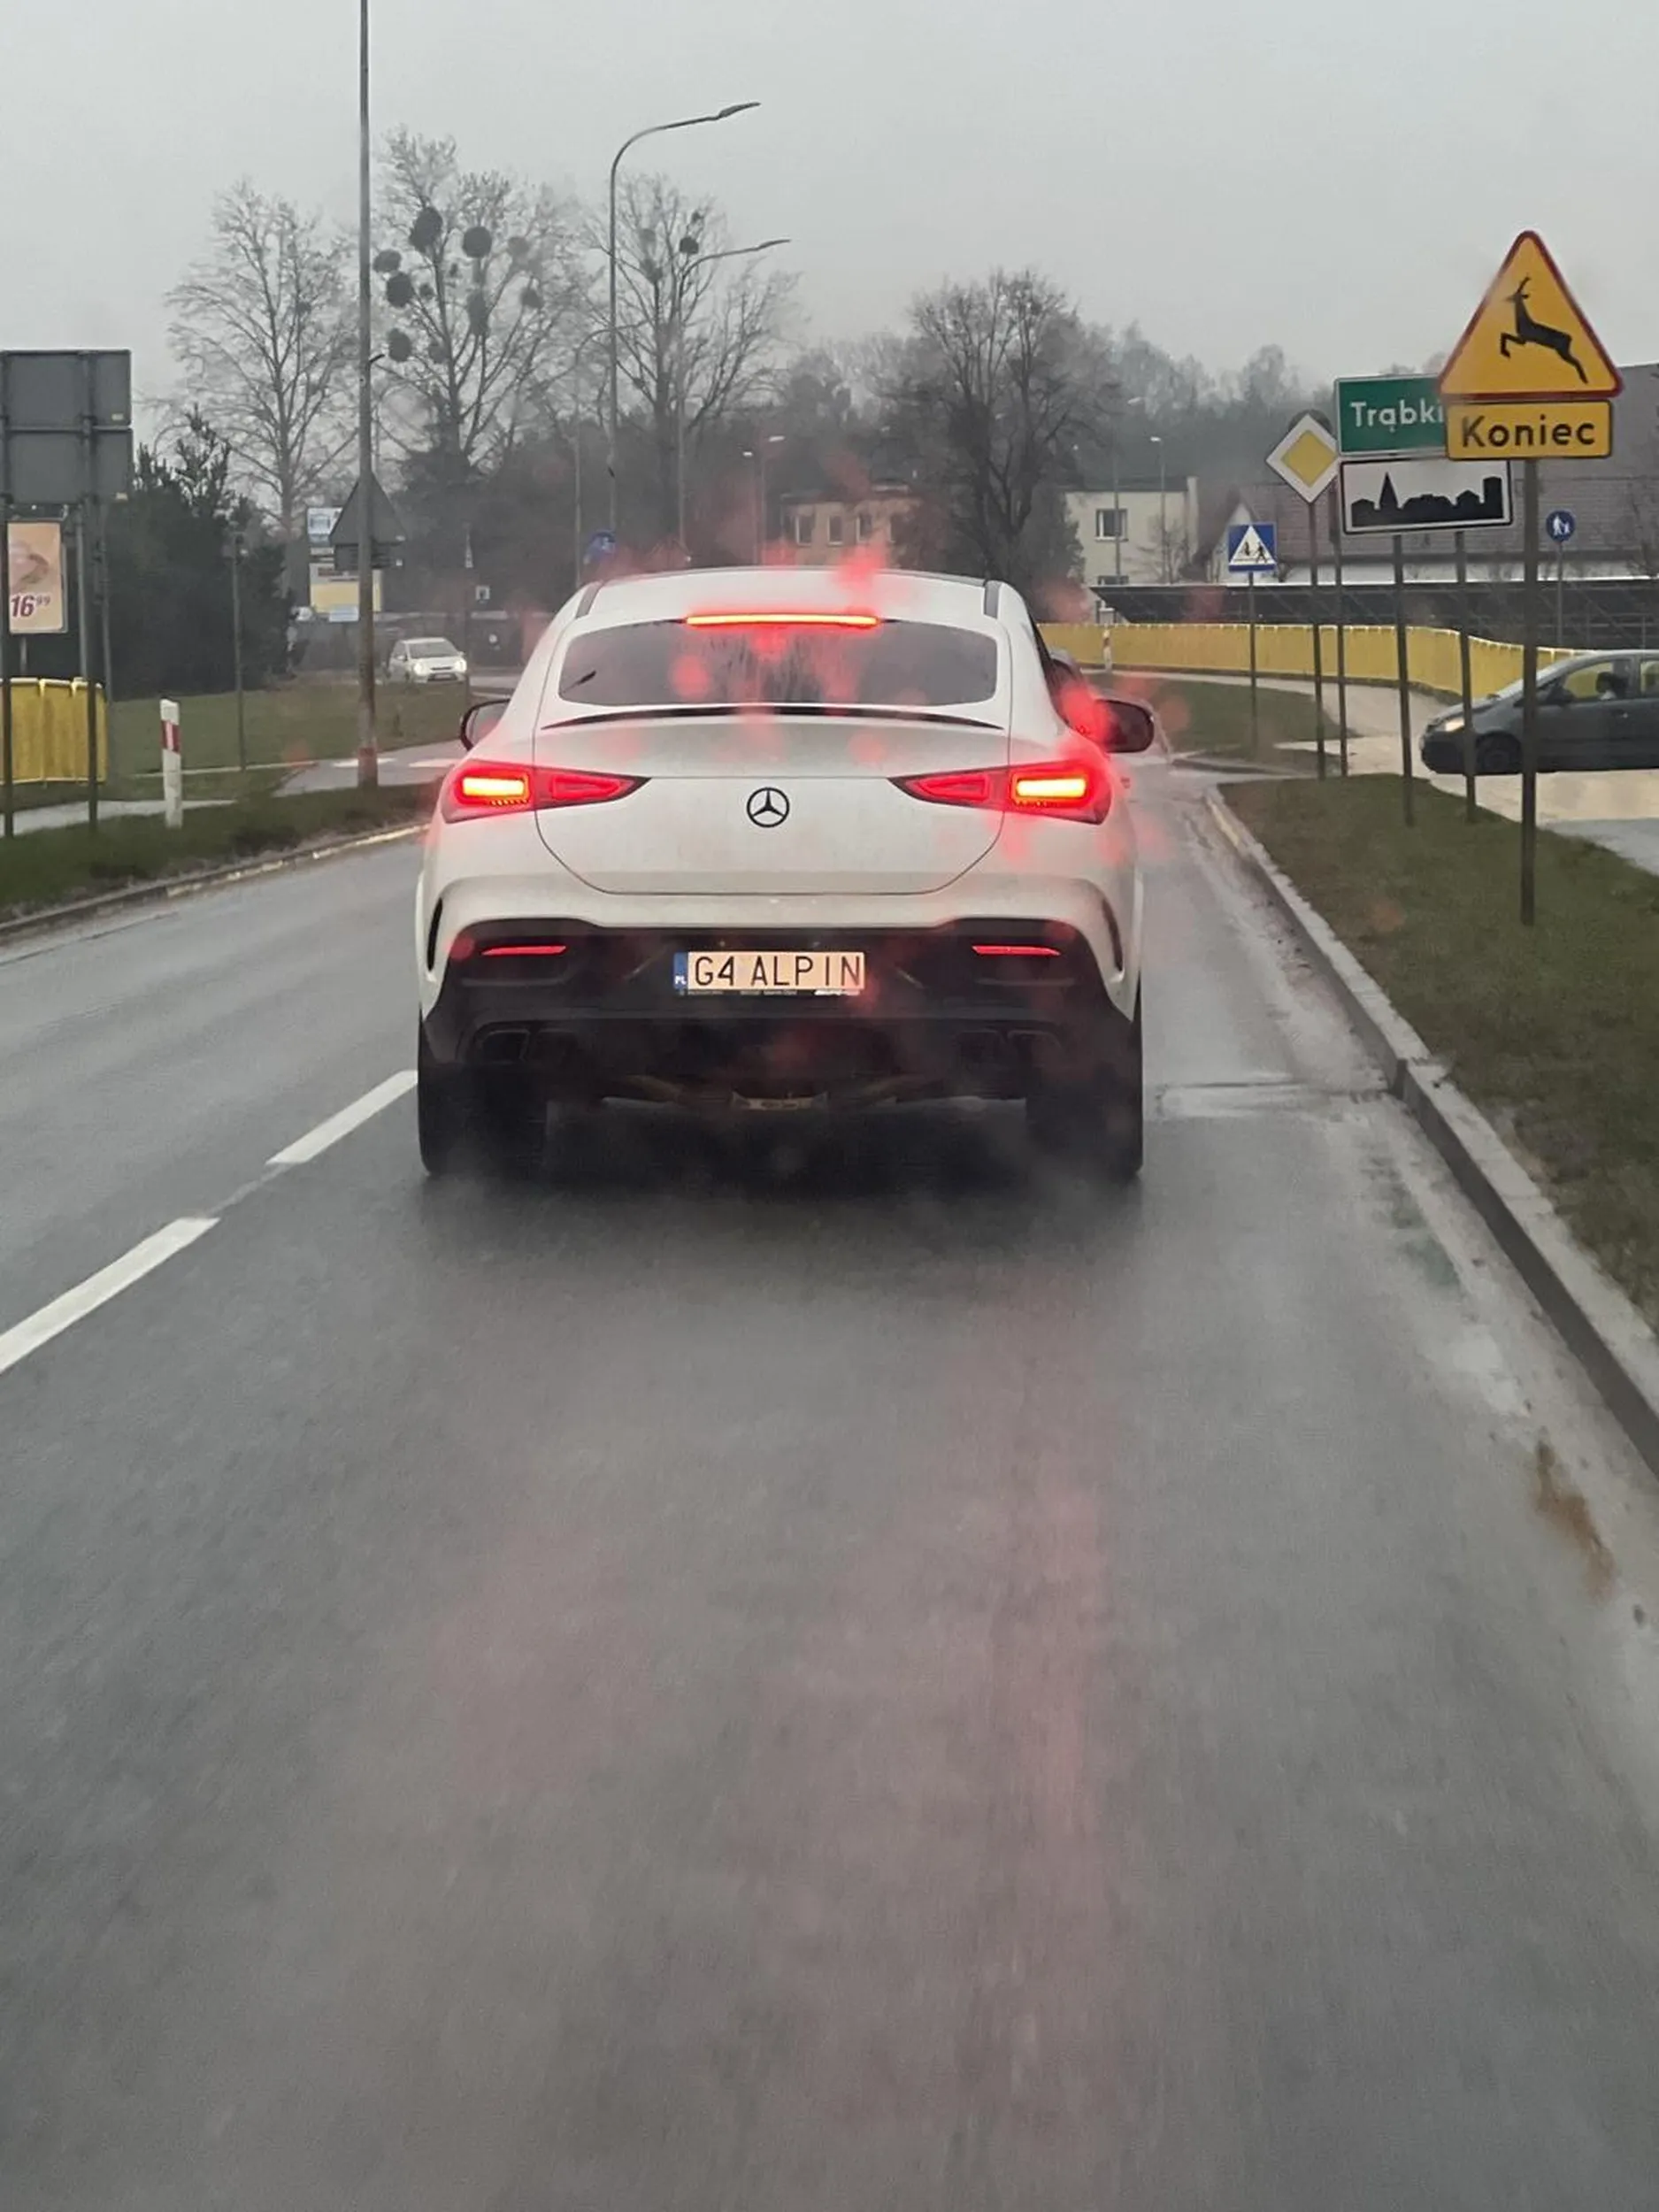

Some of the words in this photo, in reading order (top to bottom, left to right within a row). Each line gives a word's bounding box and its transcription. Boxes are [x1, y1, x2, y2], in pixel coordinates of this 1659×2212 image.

[1350, 398, 1445, 433] Trąbki
[1462, 414, 1595, 448] Koniec
[695, 956, 734, 986] G4
[751, 956, 860, 986] ALPIN
